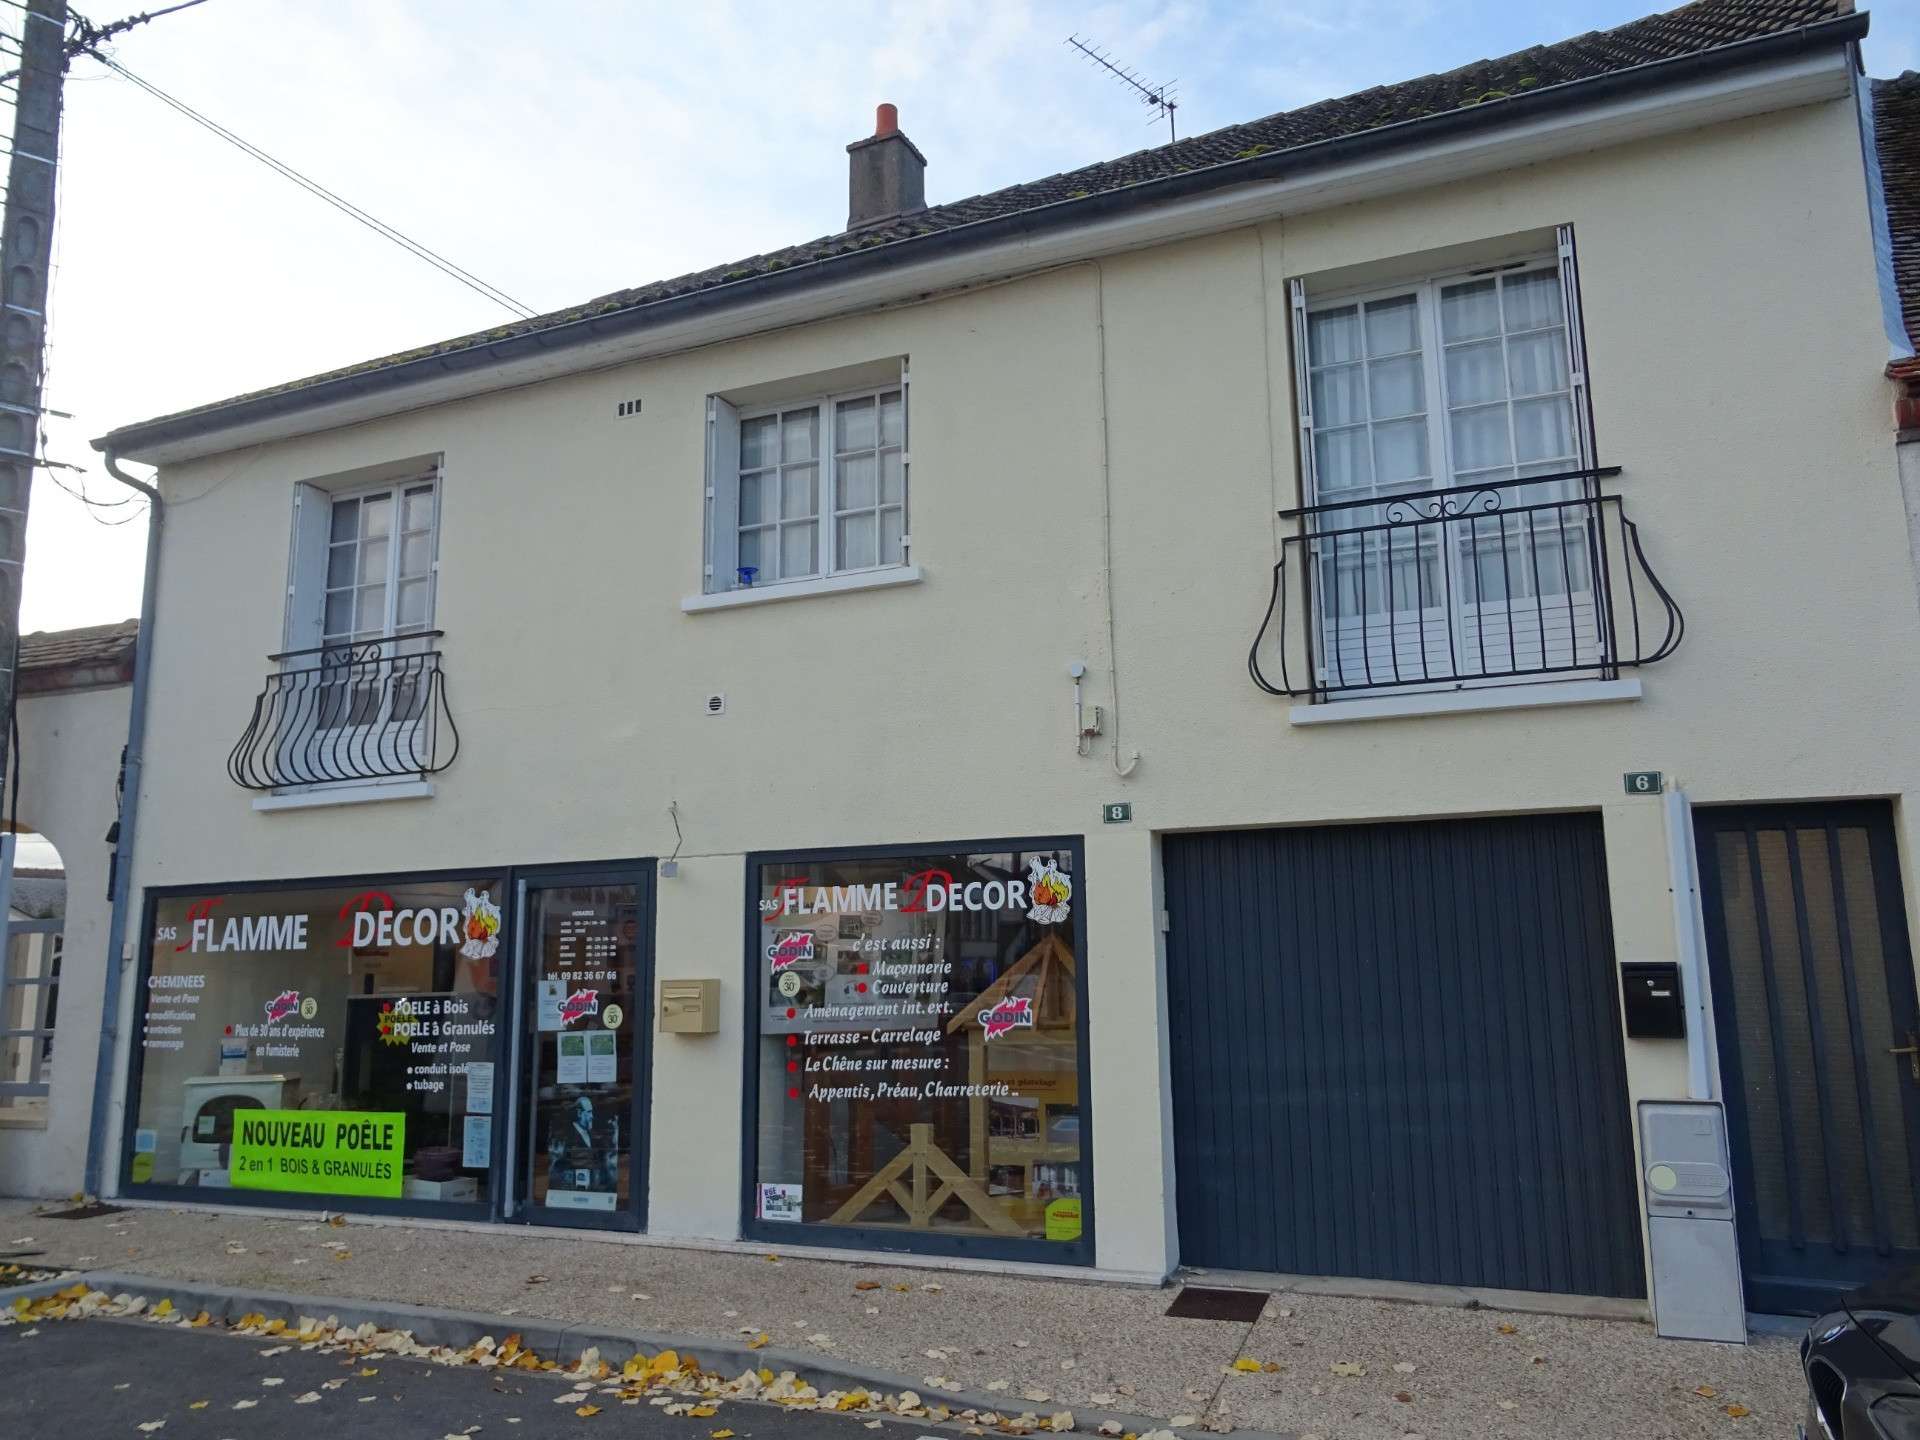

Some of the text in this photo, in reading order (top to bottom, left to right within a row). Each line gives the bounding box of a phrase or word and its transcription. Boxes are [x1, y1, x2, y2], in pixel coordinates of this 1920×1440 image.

[1636, 775, 1648, 790] 6
[1112, 806, 1122, 819] 8
[759, 899, 778, 911] SAS
[784, 882, 898, 916] FLAMME
[926, 880, 1028, 913] DECOR
[157, 926, 177, 942] SAS
[191, 914, 308, 953] FLAMME
[352, 907, 461, 948] DECOR
[852, 933, 887, 951] c'est
[891, 933, 932, 950] aussi
[766, 944, 813, 958] GODIN
[561, 971, 572, 981] 09
[606, 971, 617, 980] 66
[872, 959, 953, 978] Maçonnerie
[147, 975, 206, 989] CHEMINEES
[783, 980, 795, 992] 30
[872, 979, 949, 994] Couverture
[433, 1000, 441, 1015] à
[443, 999, 469, 1014] Bois
[557, 999, 598, 1013] GODIN
[803, 1001, 954, 1020] Aménagement int. ext.
[979, 1011, 1031, 1025] GODIN
[234, 1023, 325, 1040] Plus de 30 ans d'expérience
[394, 1020, 430, 1037] POELE
[442, 1019, 496, 1036] Granulés
[804, 1030, 860, 1046] Terrasse
[871, 1026, 942, 1046] Carrelage
[256, 1045, 265, 1056] en
[411, 1041, 471, 1054] Vente et Pose
[414, 1063, 447, 1074] conduit
[805, 1056, 821, 1072] Le
[822, 1055, 864, 1071] Chêne
[865, 1059, 890, 1071] sur
[891, 1058, 942, 1070] mesure
[413, 1078, 444, 1092] tubage
[242, 1119, 394, 1151] NOUVEAU POÊLE
[238, 1155, 393, 1180] 2 en 1 BOIS & GRANULÉS
